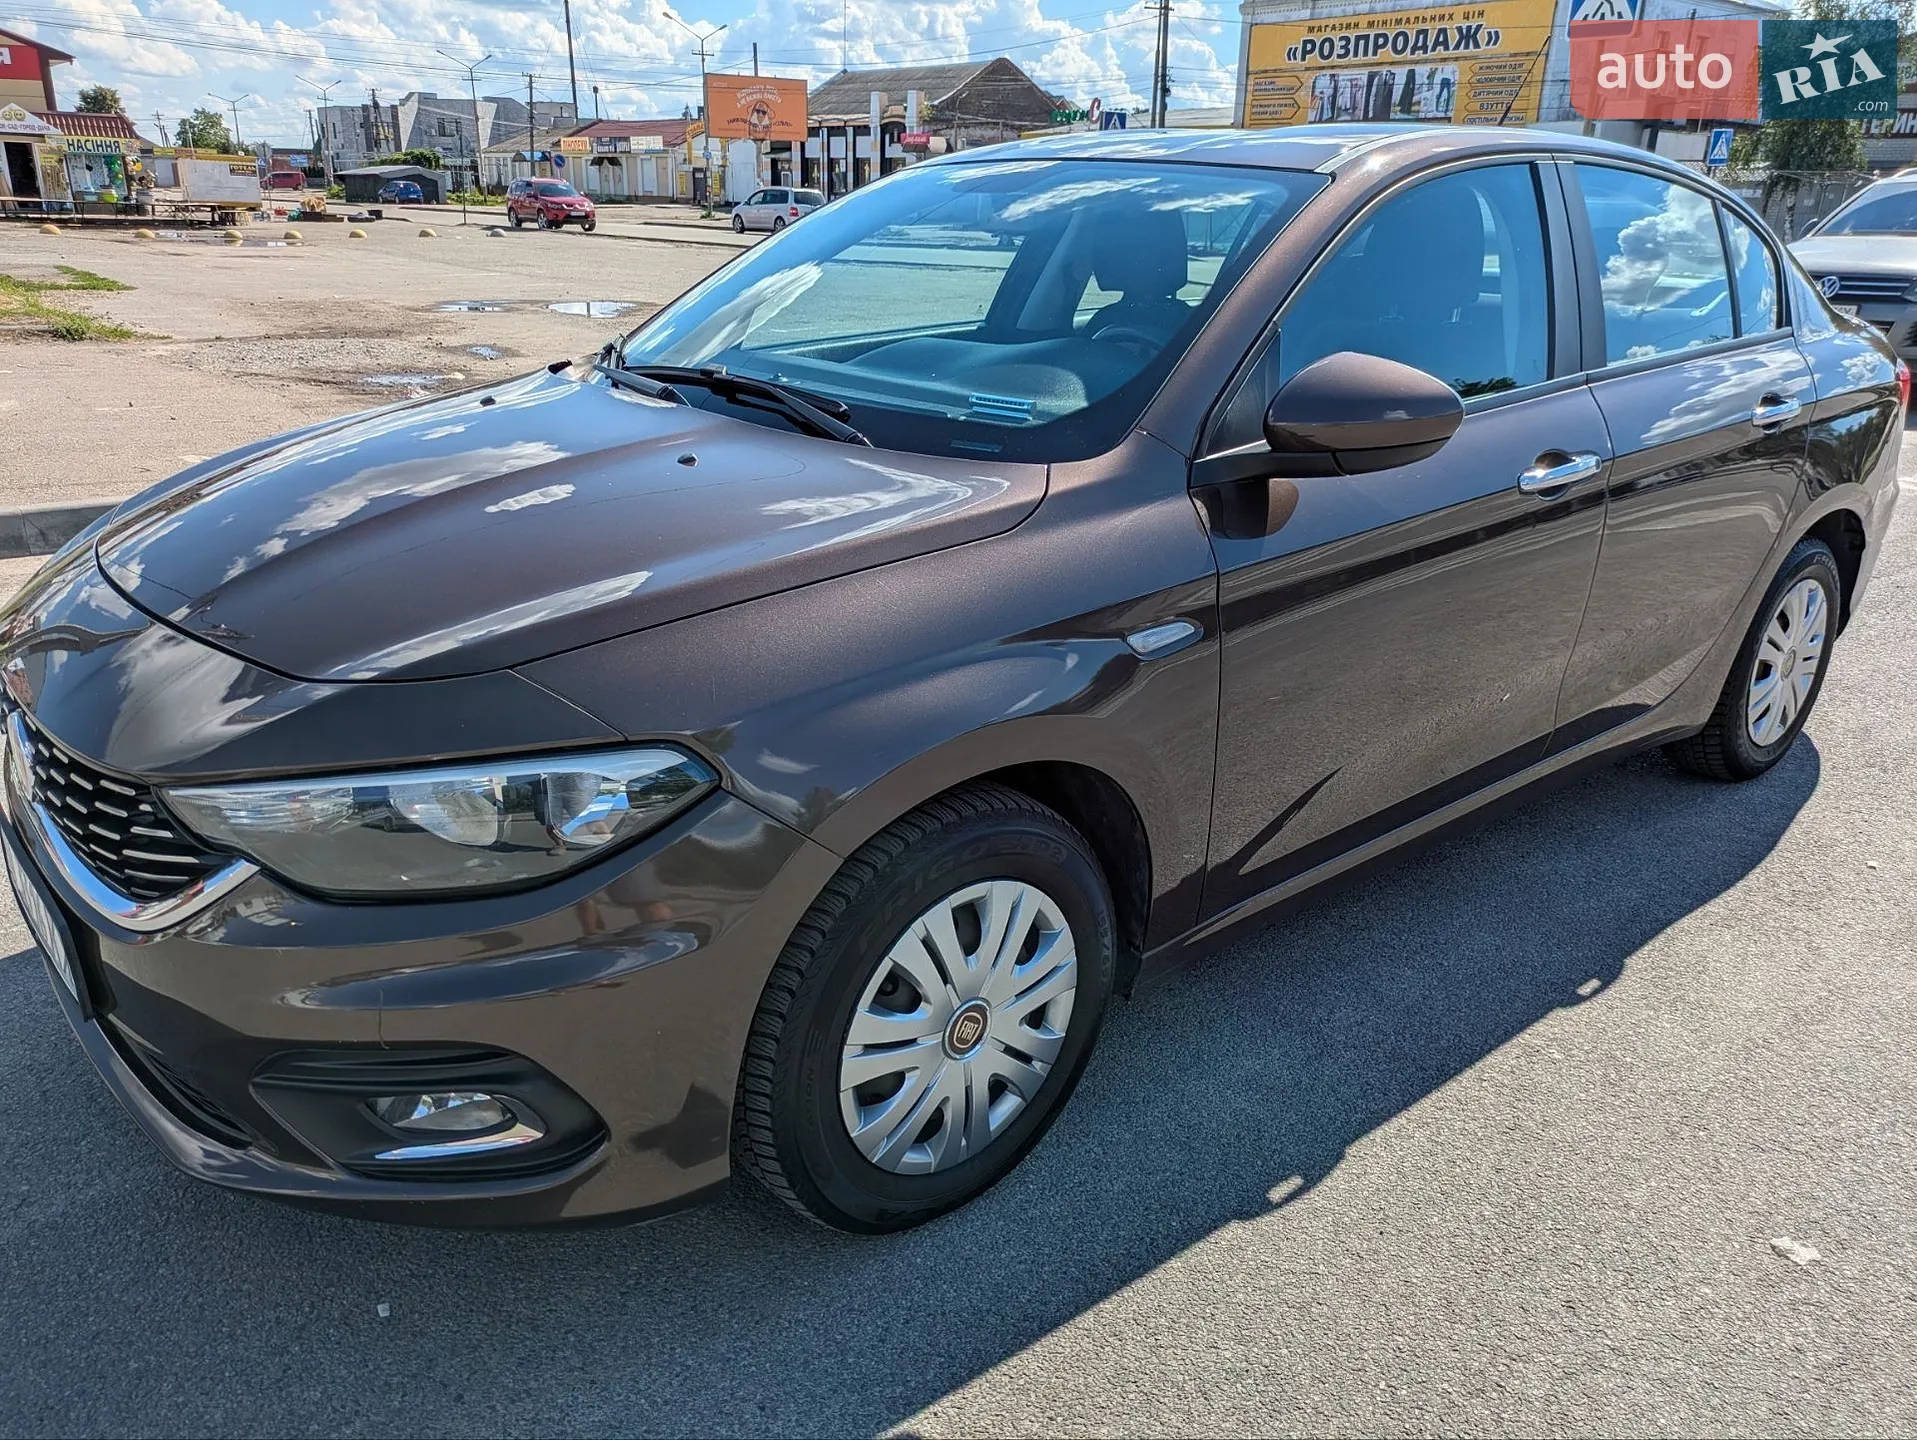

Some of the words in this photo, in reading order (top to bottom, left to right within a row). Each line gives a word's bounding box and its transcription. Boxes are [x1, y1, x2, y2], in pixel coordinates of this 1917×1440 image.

[1307, 21, 1360, 34] МАГАЗИН
[1367, 13, 1455, 30] МІНІМАЛЬНИХ
[1462, 10, 1486, 21] ЦІН
[1285, 23, 1501, 63] «РОЗПРОДАЖ»
[66, 138, 121, 153] НАСІННЯ
[957, 1020, 979, 1041] FIAT
